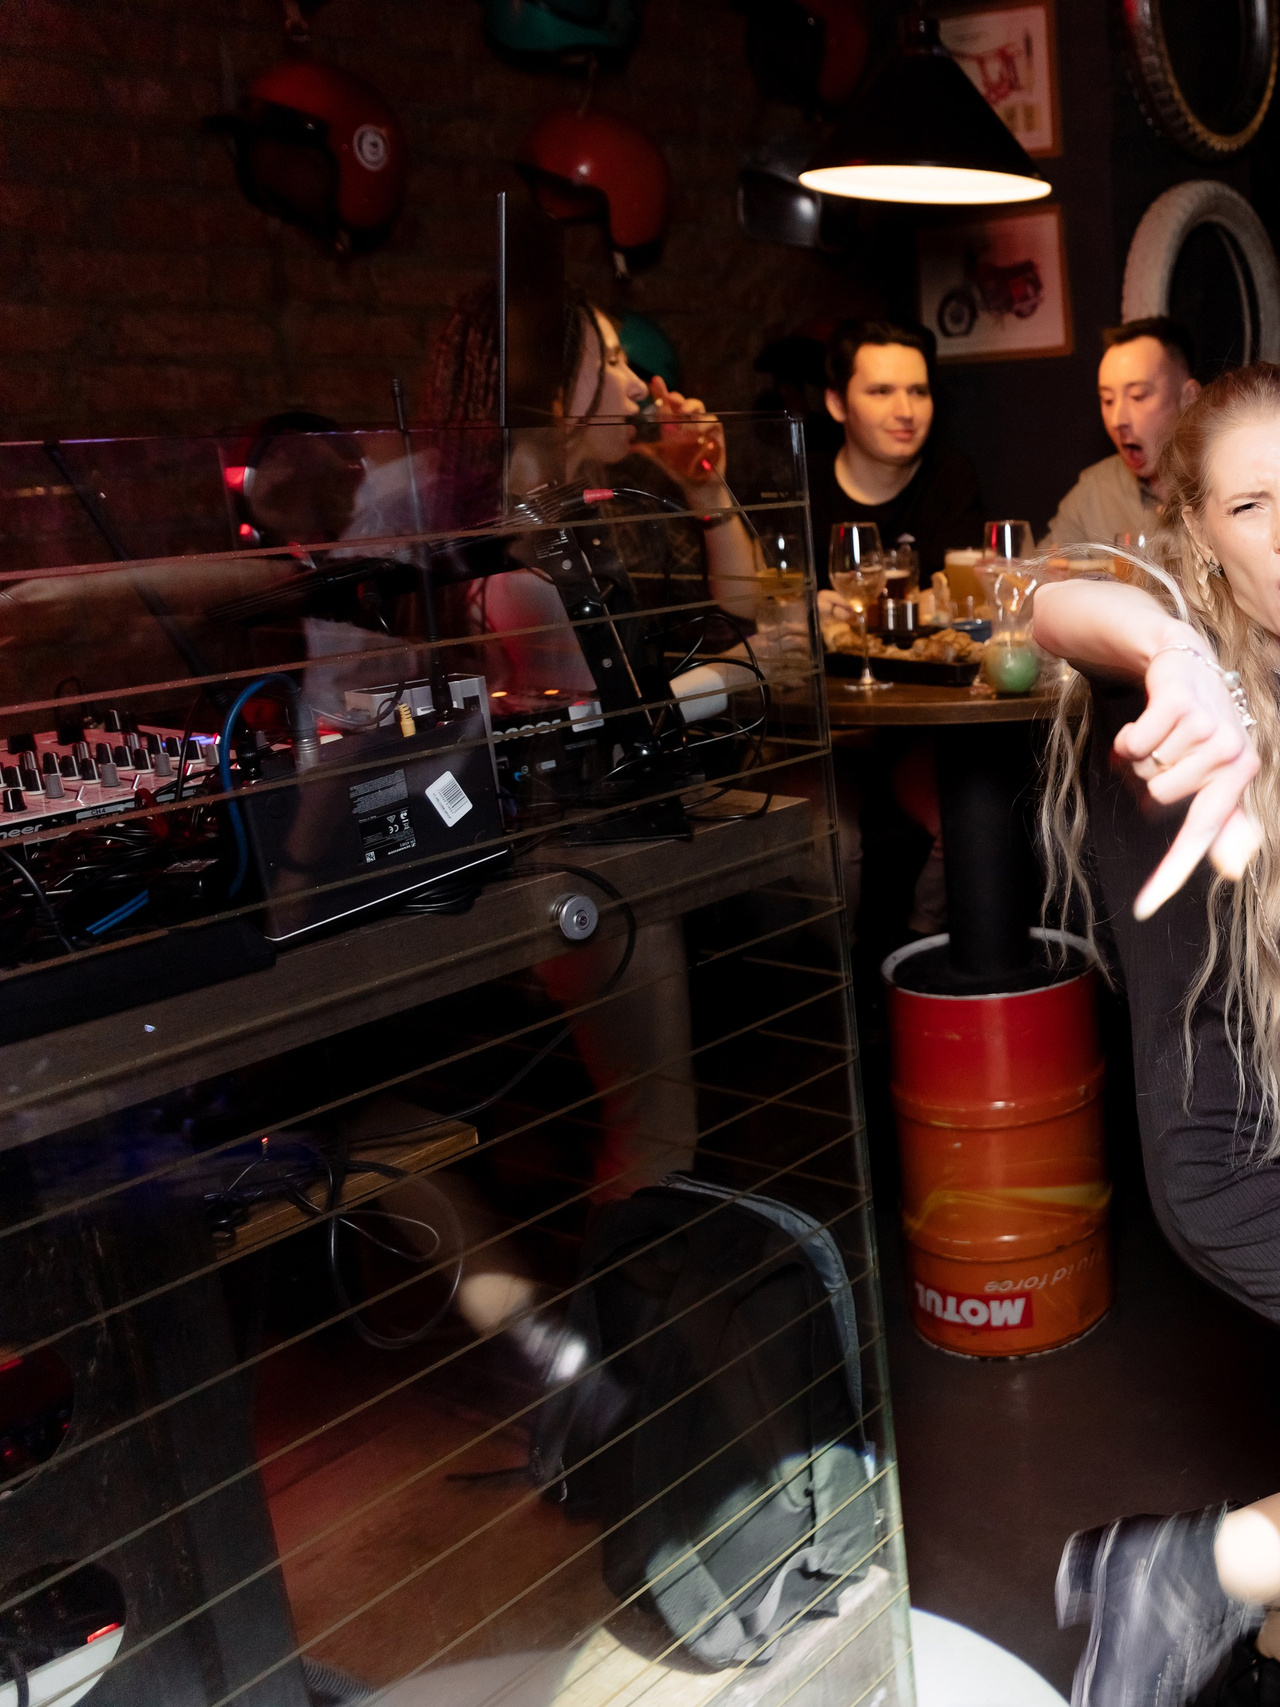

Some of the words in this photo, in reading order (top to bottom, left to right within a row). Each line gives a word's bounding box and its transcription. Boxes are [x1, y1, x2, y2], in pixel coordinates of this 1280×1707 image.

[91, 808, 107, 816] CH4
[984, 1273, 1048, 1293] force
[915, 1280, 1026, 1326] MOTUL
